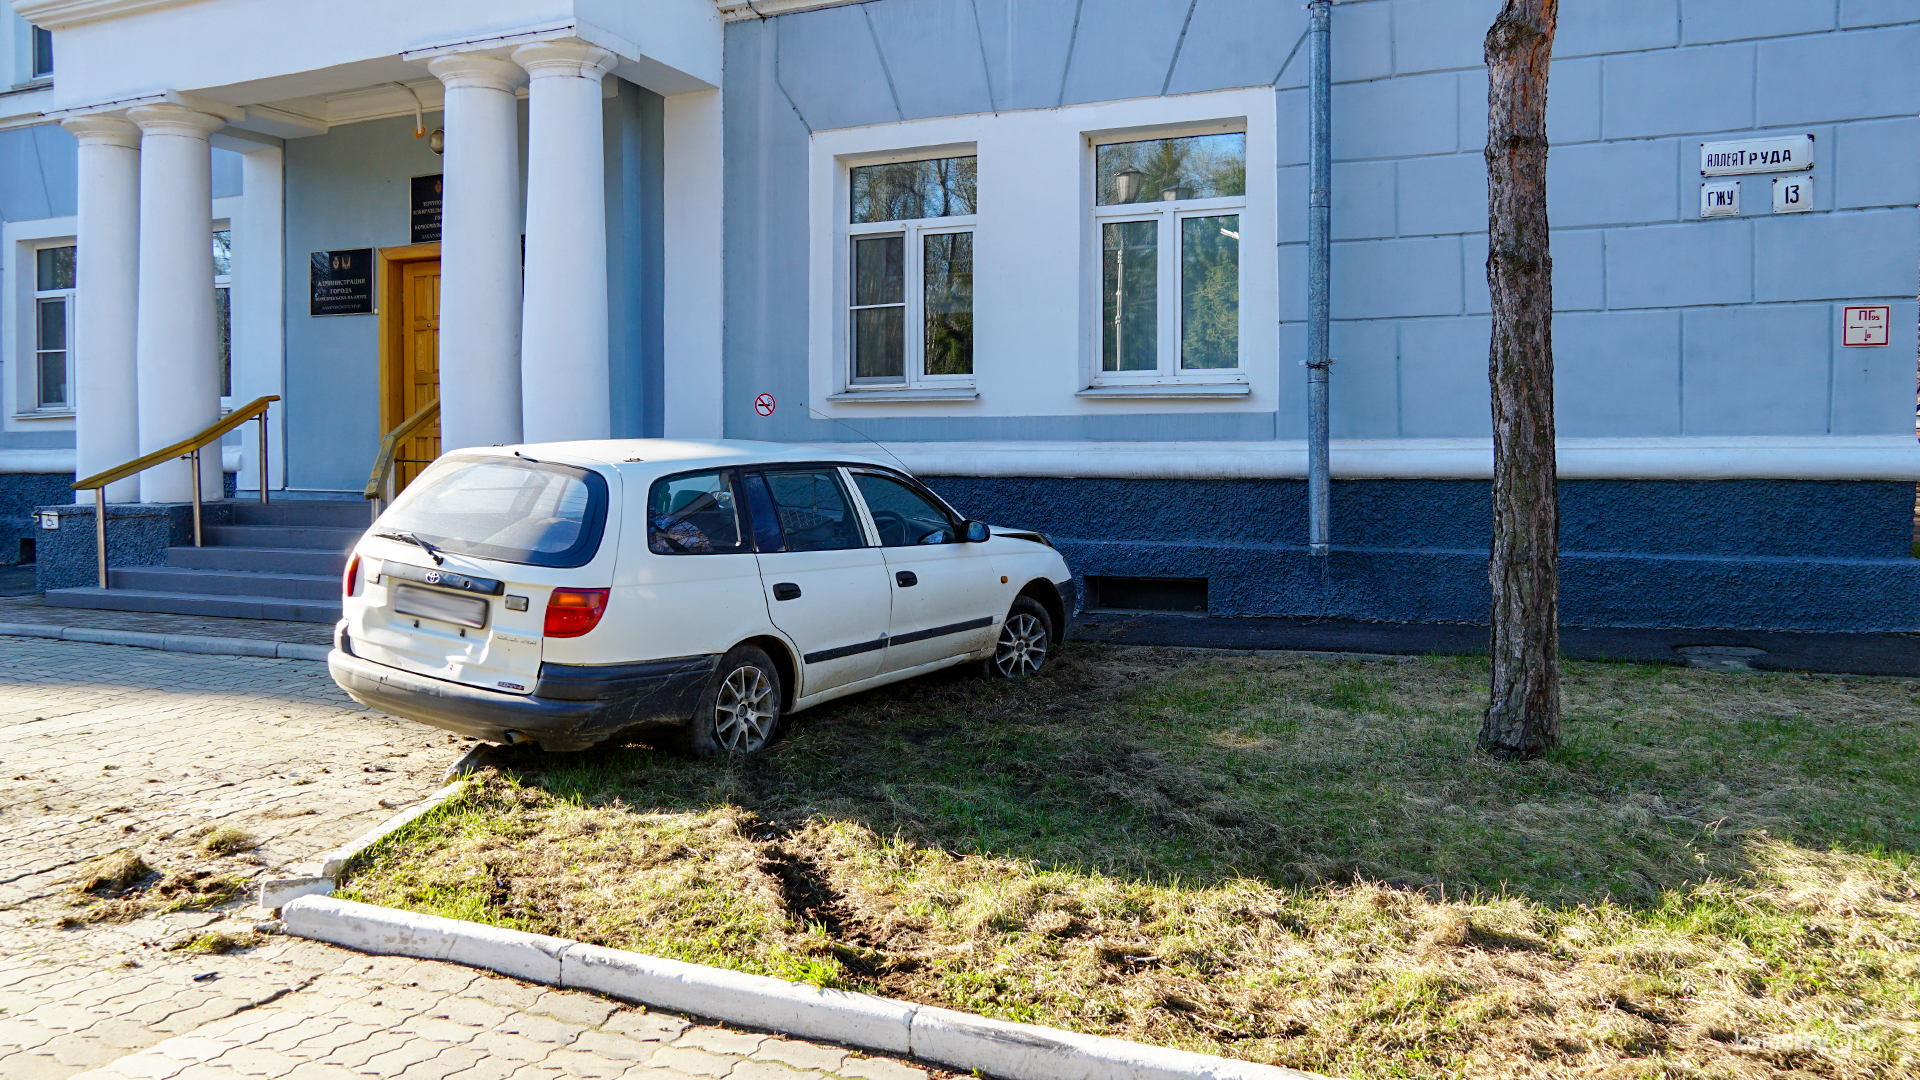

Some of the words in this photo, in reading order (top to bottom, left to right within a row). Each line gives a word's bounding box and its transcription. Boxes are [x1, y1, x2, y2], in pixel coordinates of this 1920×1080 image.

[1707, 153, 1738, 167] АЛЛЕЯ
[1738, 149, 1792, 166] ТРУДА
[1707, 190, 1734, 207] ГЖУ
[1785, 184, 1800, 204] 13
[317, 278, 366, 287] АДМИНИСТРАЦИЯ
[330, 287, 353, 295] ГОРОДА
